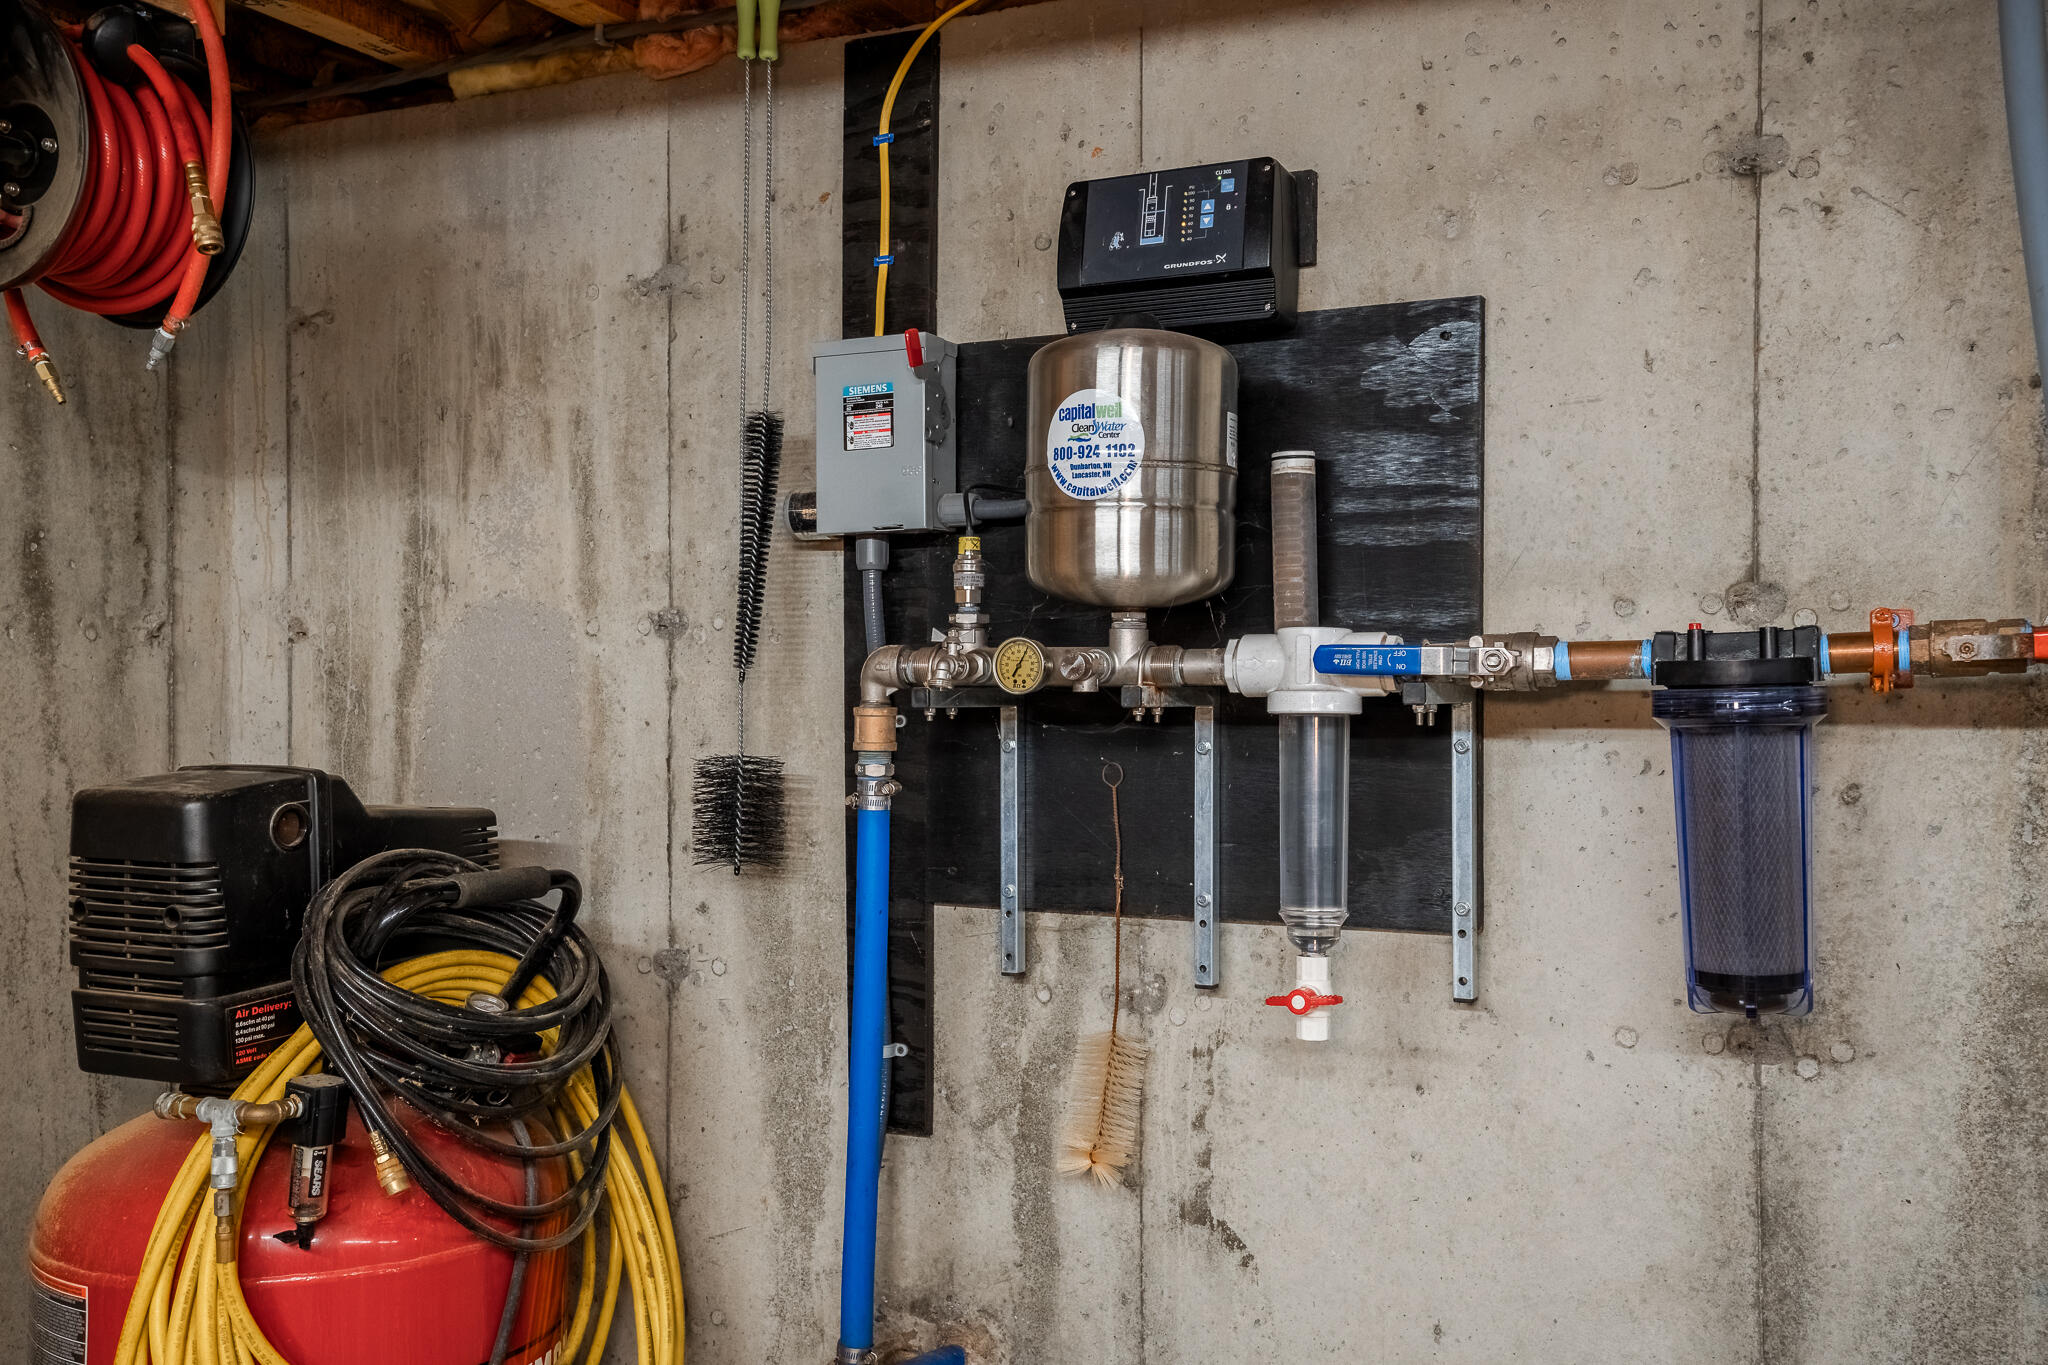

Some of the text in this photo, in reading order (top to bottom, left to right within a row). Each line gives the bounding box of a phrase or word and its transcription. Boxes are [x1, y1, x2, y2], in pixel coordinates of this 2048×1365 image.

[1164, 260, 1213, 270] GRUNDFOS
[849, 384, 887, 395] SIEMENS
[1072, 471, 1101, 479] Lancaster,
[236, 1001, 291, 1018] Air Delivery:
[311, 1160, 324, 1196] SEARS
